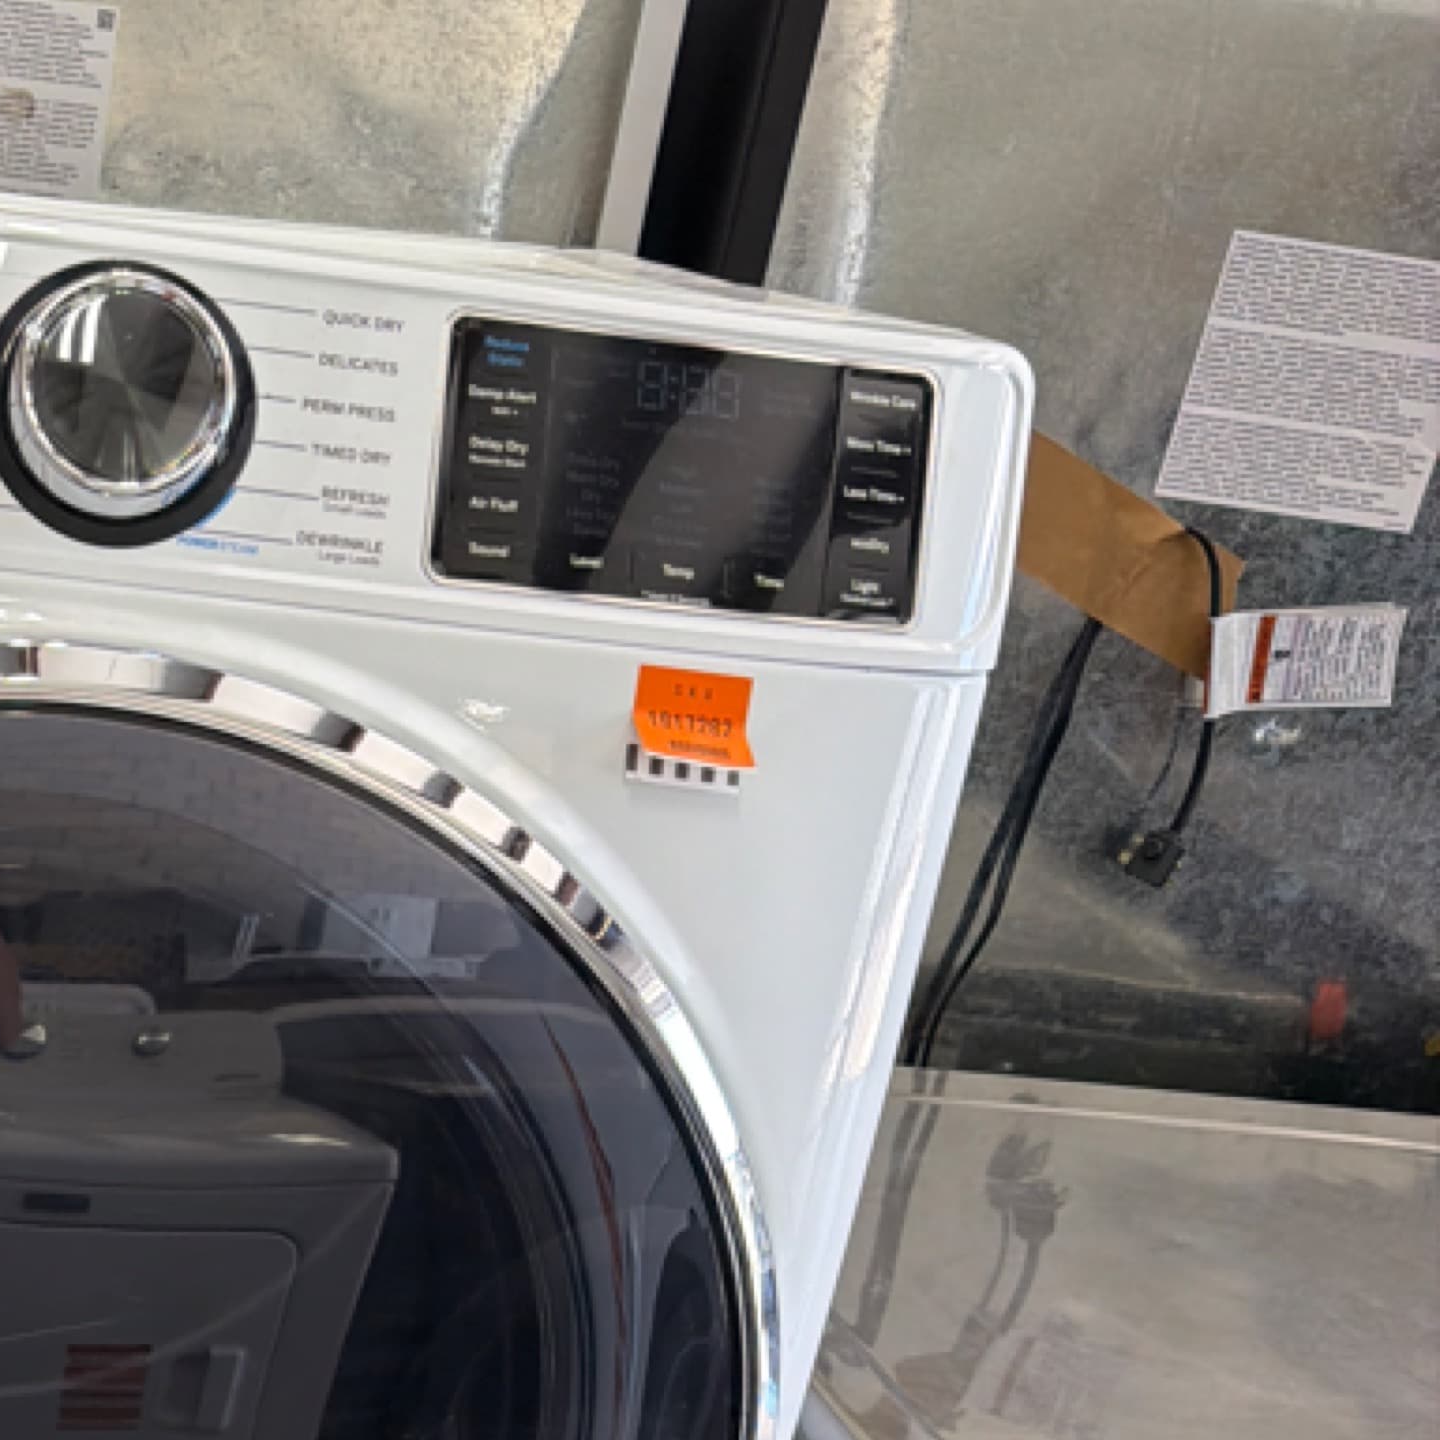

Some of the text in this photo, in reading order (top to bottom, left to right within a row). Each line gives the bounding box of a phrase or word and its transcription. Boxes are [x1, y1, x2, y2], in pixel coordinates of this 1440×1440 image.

[323, 309, 405, 333] QUICK DRY
[318, 351, 399, 376] DELICATES
[303, 396, 396, 423] PERM PRESS
[311, 443, 391, 466] TIMED DRY
[322, 485, 390, 506] REFRESH
